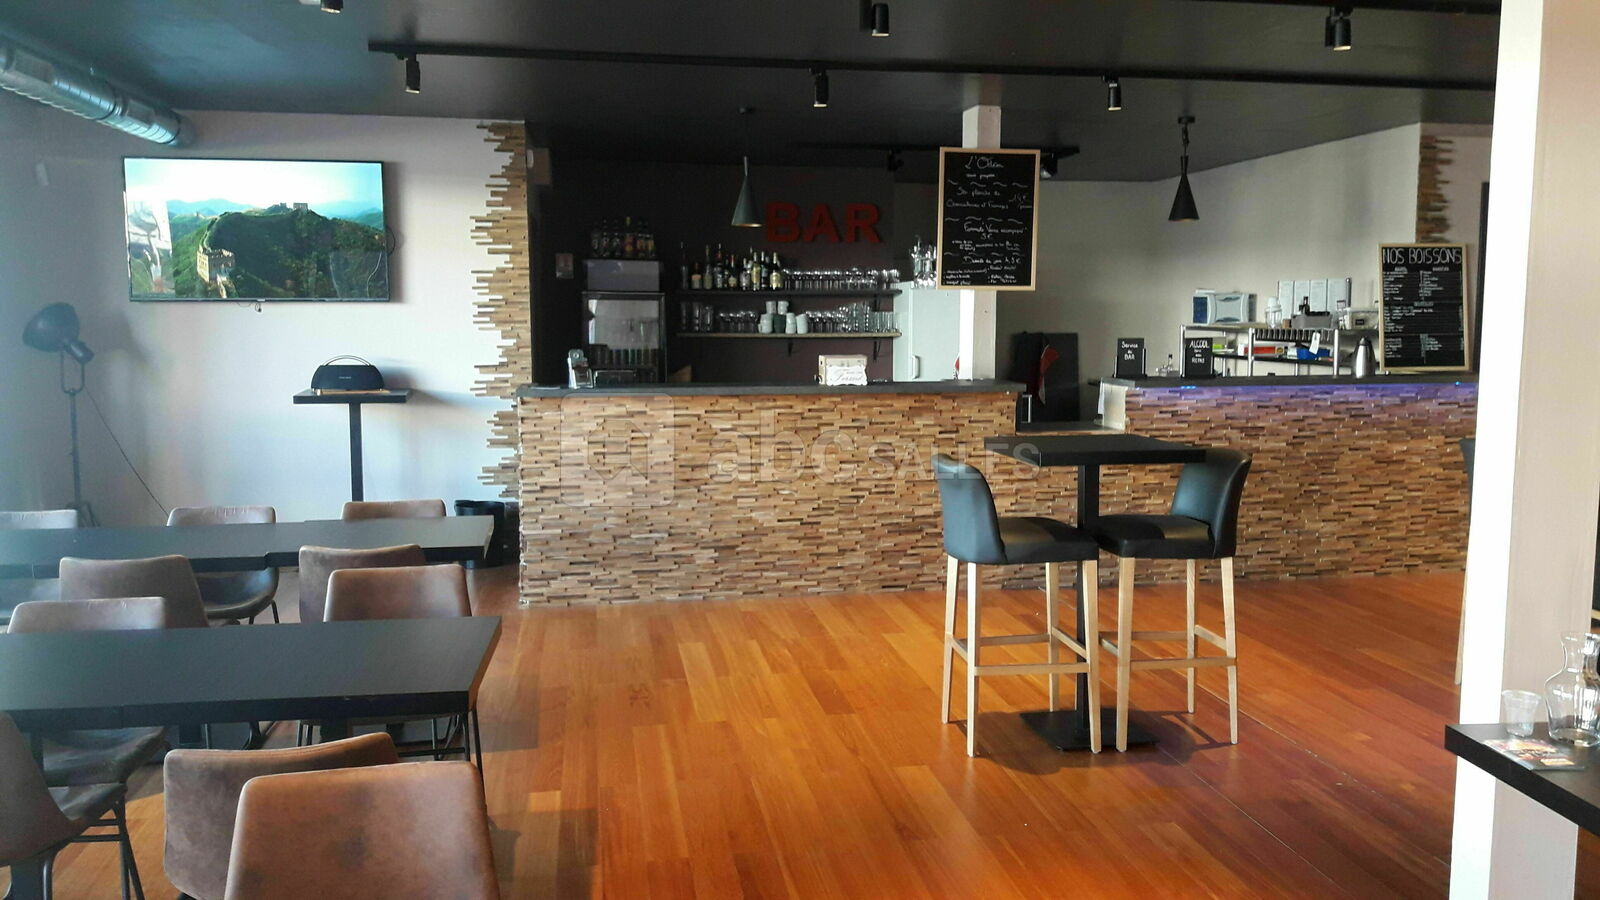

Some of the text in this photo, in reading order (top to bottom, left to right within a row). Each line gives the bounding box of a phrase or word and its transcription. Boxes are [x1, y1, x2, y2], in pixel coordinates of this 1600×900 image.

[766, 201, 881, 243] BAR
[1382, 247, 1462, 265] NOS BOISSONS
[1121, 340, 1139, 349] Service
[1189, 339, 1210, 349] ALCOOL
[1124, 353, 1136, 361] BAR
